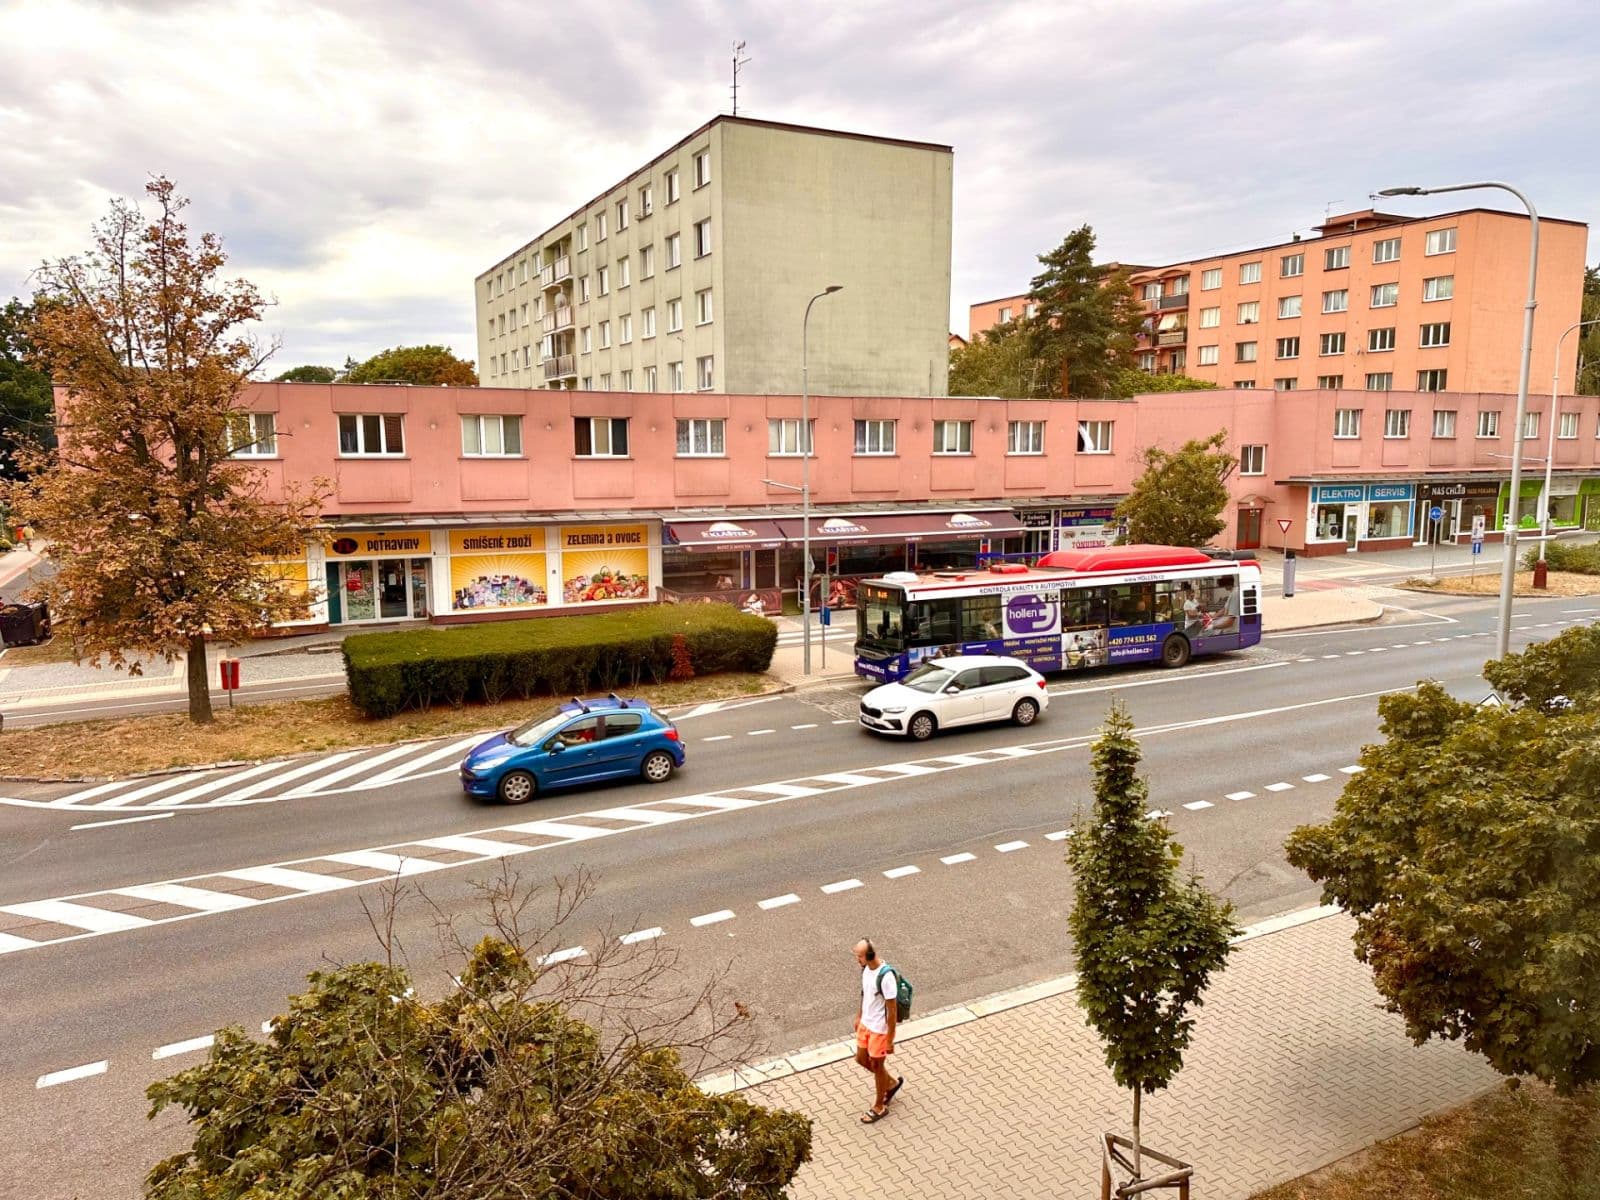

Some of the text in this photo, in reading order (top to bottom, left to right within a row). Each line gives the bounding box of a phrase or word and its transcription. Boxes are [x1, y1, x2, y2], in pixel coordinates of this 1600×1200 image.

[1321, 488, 1361, 499] ELEKTRO
[1374, 487, 1406, 497] SERVIS
[506, 534, 532, 548] ZBOŽÍ
[615, 531, 641, 544] OVOCE
[1012, 584, 1034, 592] KVALITY
[1040, 581, 1077, 589] AUTOMOTIVE
[1009, 608, 1038, 619] hollen
[1108, 638, 1123, 646] +420
[1146, 634, 1157, 642] 562
